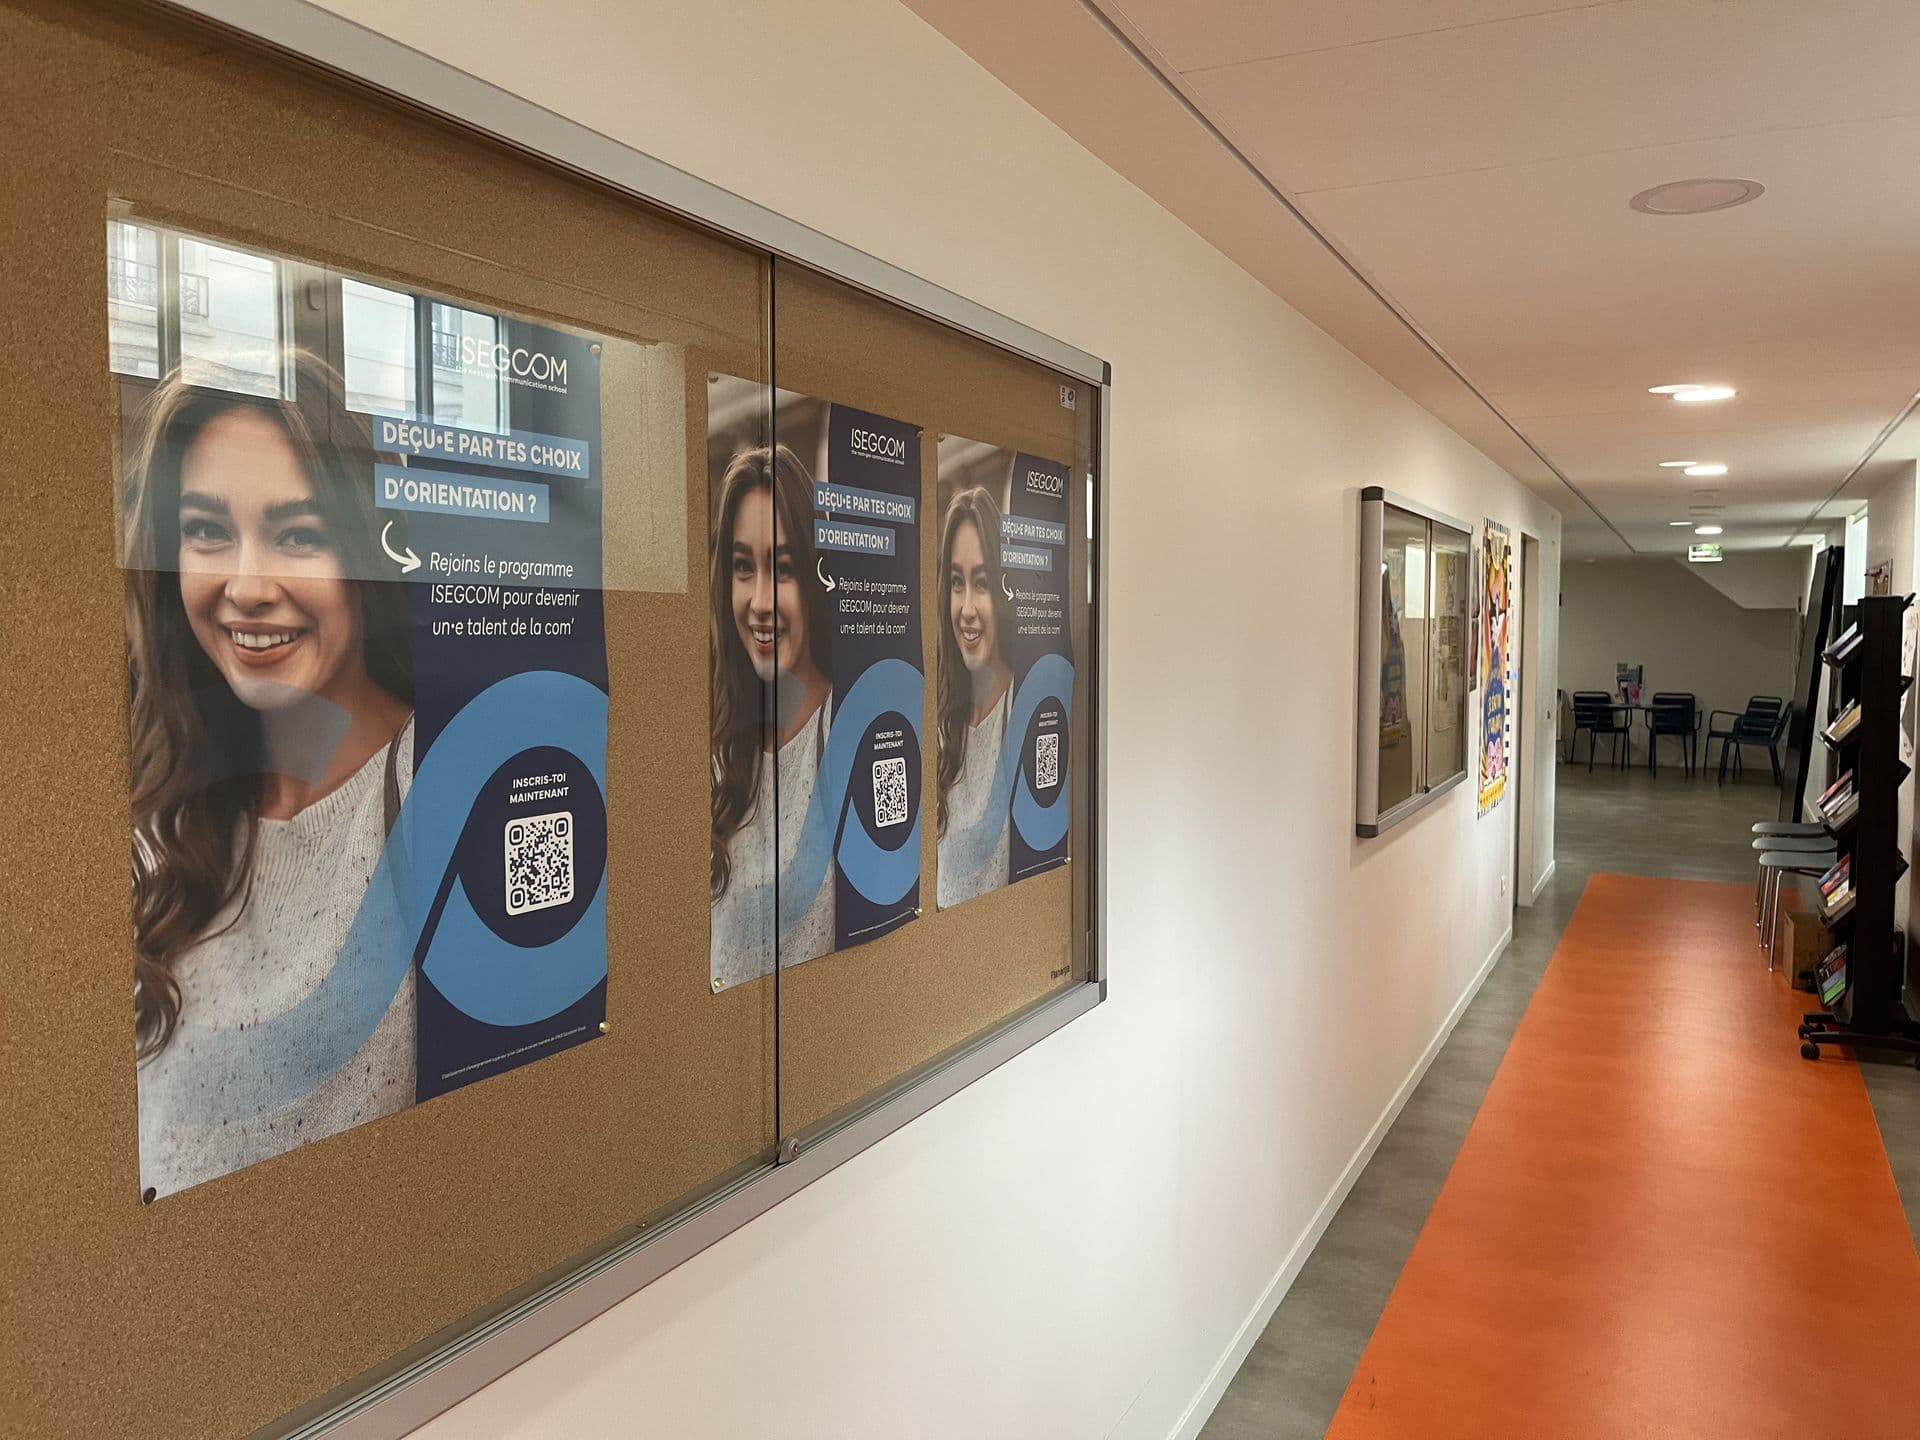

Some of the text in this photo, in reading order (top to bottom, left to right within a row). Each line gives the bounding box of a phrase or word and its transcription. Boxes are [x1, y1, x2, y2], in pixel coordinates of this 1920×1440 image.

[456, 334, 567, 384] ISEGCOM
[459, 433, 493, 458] PAR
[496, 439, 527, 463] TES
[530, 445, 581, 471] CHOIX
[851, 428, 905, 459] ISEGCOM
[1027, 471, 1064, 493] ISEGCOM
[384, 478, 537, 514] D'ORIENTATION ?
[853, 495, 870, 513] PAR
[871, 498, 885, 514] TES
[887, 502, 911, 519] CHOIX
[819, 528, 890, 550] D'ORIENTATION ?
[430, 552, 573, 580] Rejoins le programme
[431, 584, 580, 609] ISEGCOM pour devenir
[839, 577, 907, 596] Rejoins le programme
[840, 599, 910, 617] ISEGCOM pour devenir
[467, 617, 508, 636] talent
[510, 617, 527, 636] de
[530, 617, 541, 636] la
[545, 617, 574, 636] com'
[876, 621, 885, 634] de
[886, 621, 892, 634] la
[512, 772, 567, 789] INSCRIS-TOI
[509, 787, 569, 804] MAINTENANT
